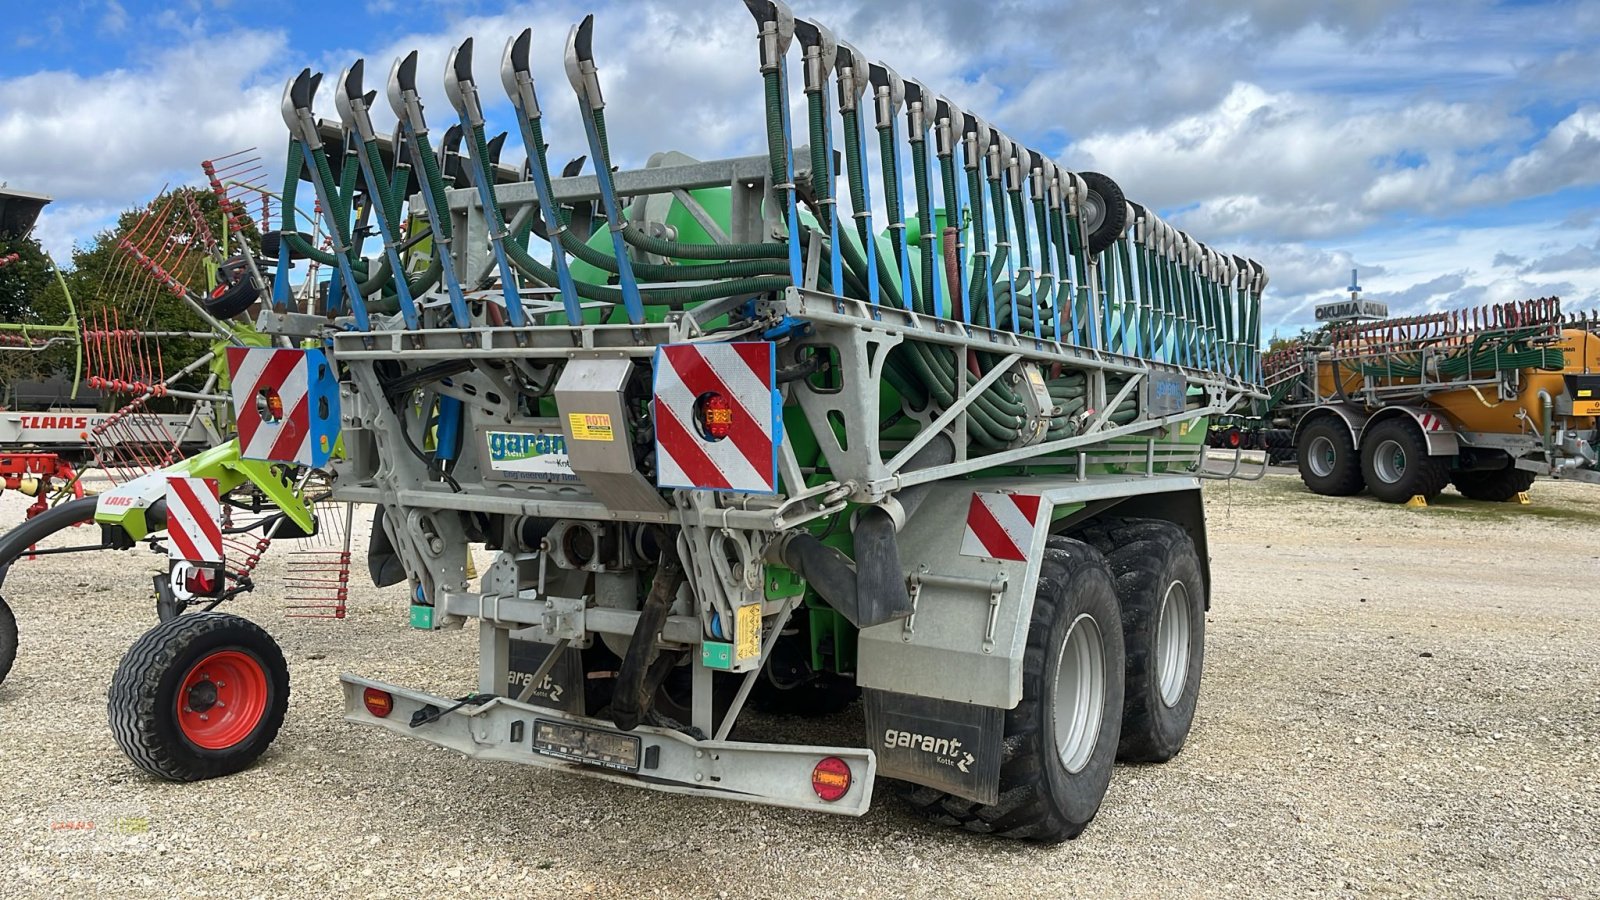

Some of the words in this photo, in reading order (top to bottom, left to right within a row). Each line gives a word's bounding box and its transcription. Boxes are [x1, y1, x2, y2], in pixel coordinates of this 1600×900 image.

[1315, 302, 1361, 319] OKUMA
[20, 416, 87, 429] CLAAS
[585, 415, 610, 426] ROTH
[491, 433, 568, 460] garan
[175, 567, 184, 592] 4
[884, 728, 962, 757] garant
[936, 756, 955, 767] Kotte
